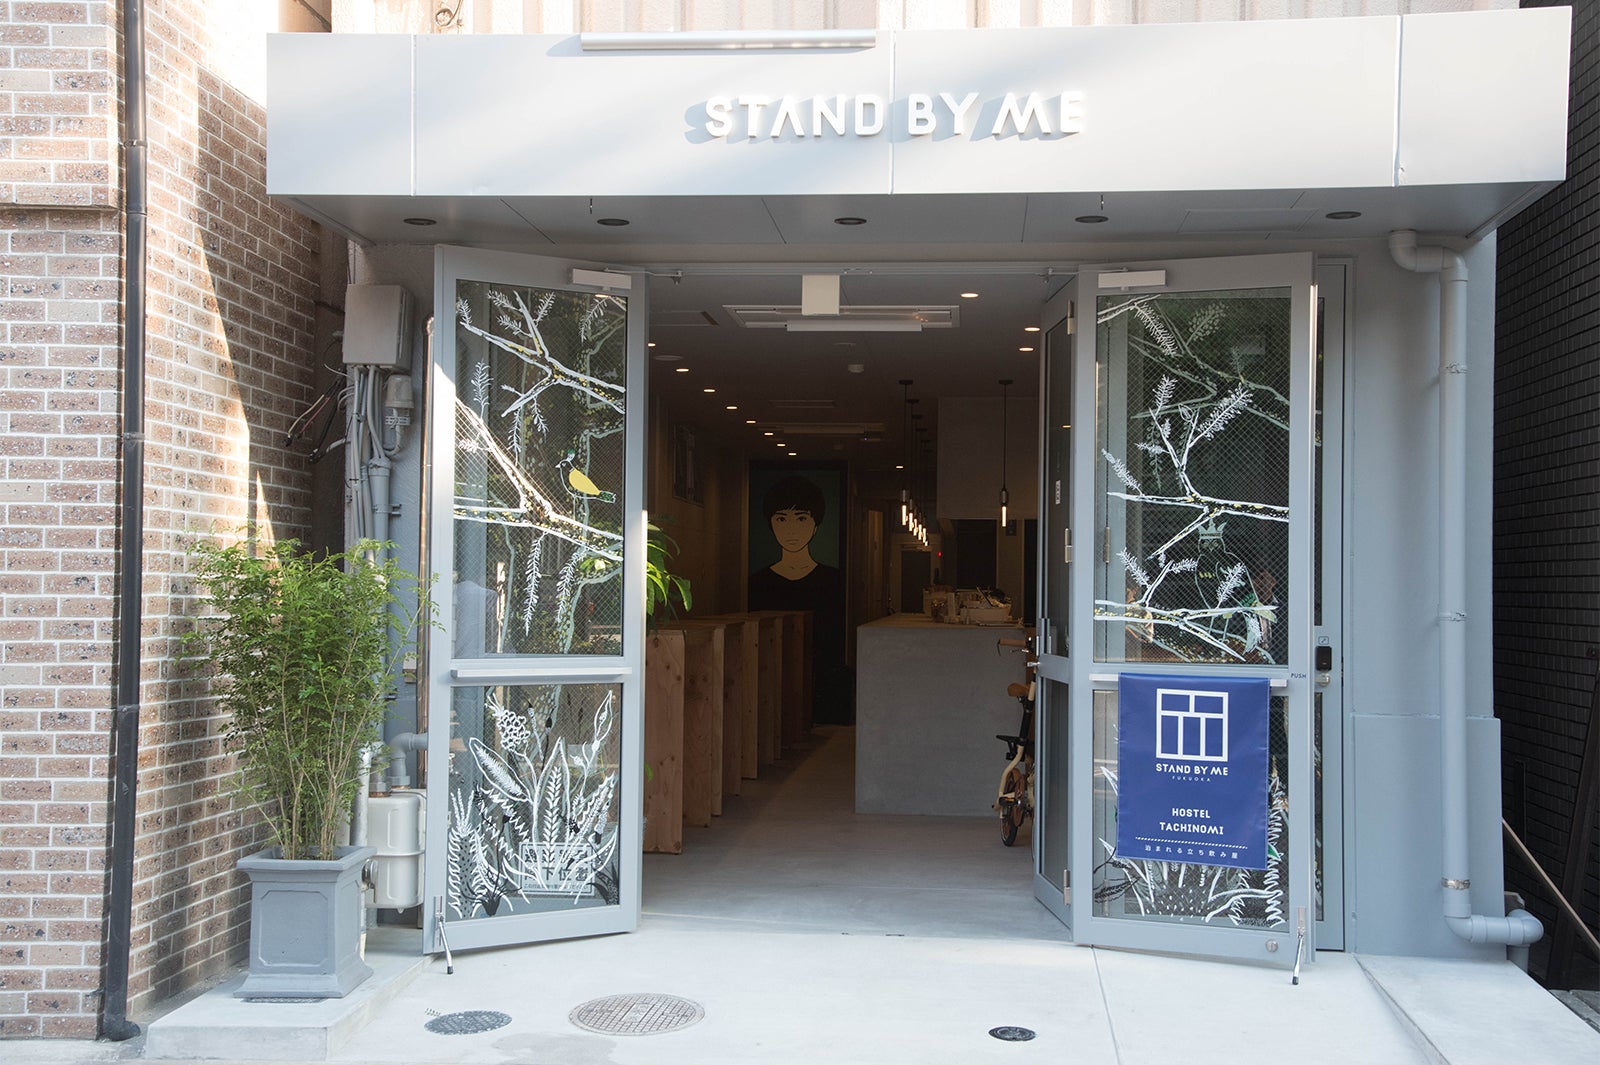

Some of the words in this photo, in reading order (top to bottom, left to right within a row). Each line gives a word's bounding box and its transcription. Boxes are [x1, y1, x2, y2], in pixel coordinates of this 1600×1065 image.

[704, 93, 884, 137] STAND
[907, 92, 980, 136] BY
[991, 91, 1086, 135] ME
[1155, 763, 1191, 774] STAND
[1194, 765, 1208, 775] BY
[1210, 766, 1229, 776] ME
[1172, 807, 1211, 819] HOSTEL
[1159, 821, 1224, 835] TACHINOMI
[1144, 844, 1239, 859] 泊まれる立ち飲み屋
